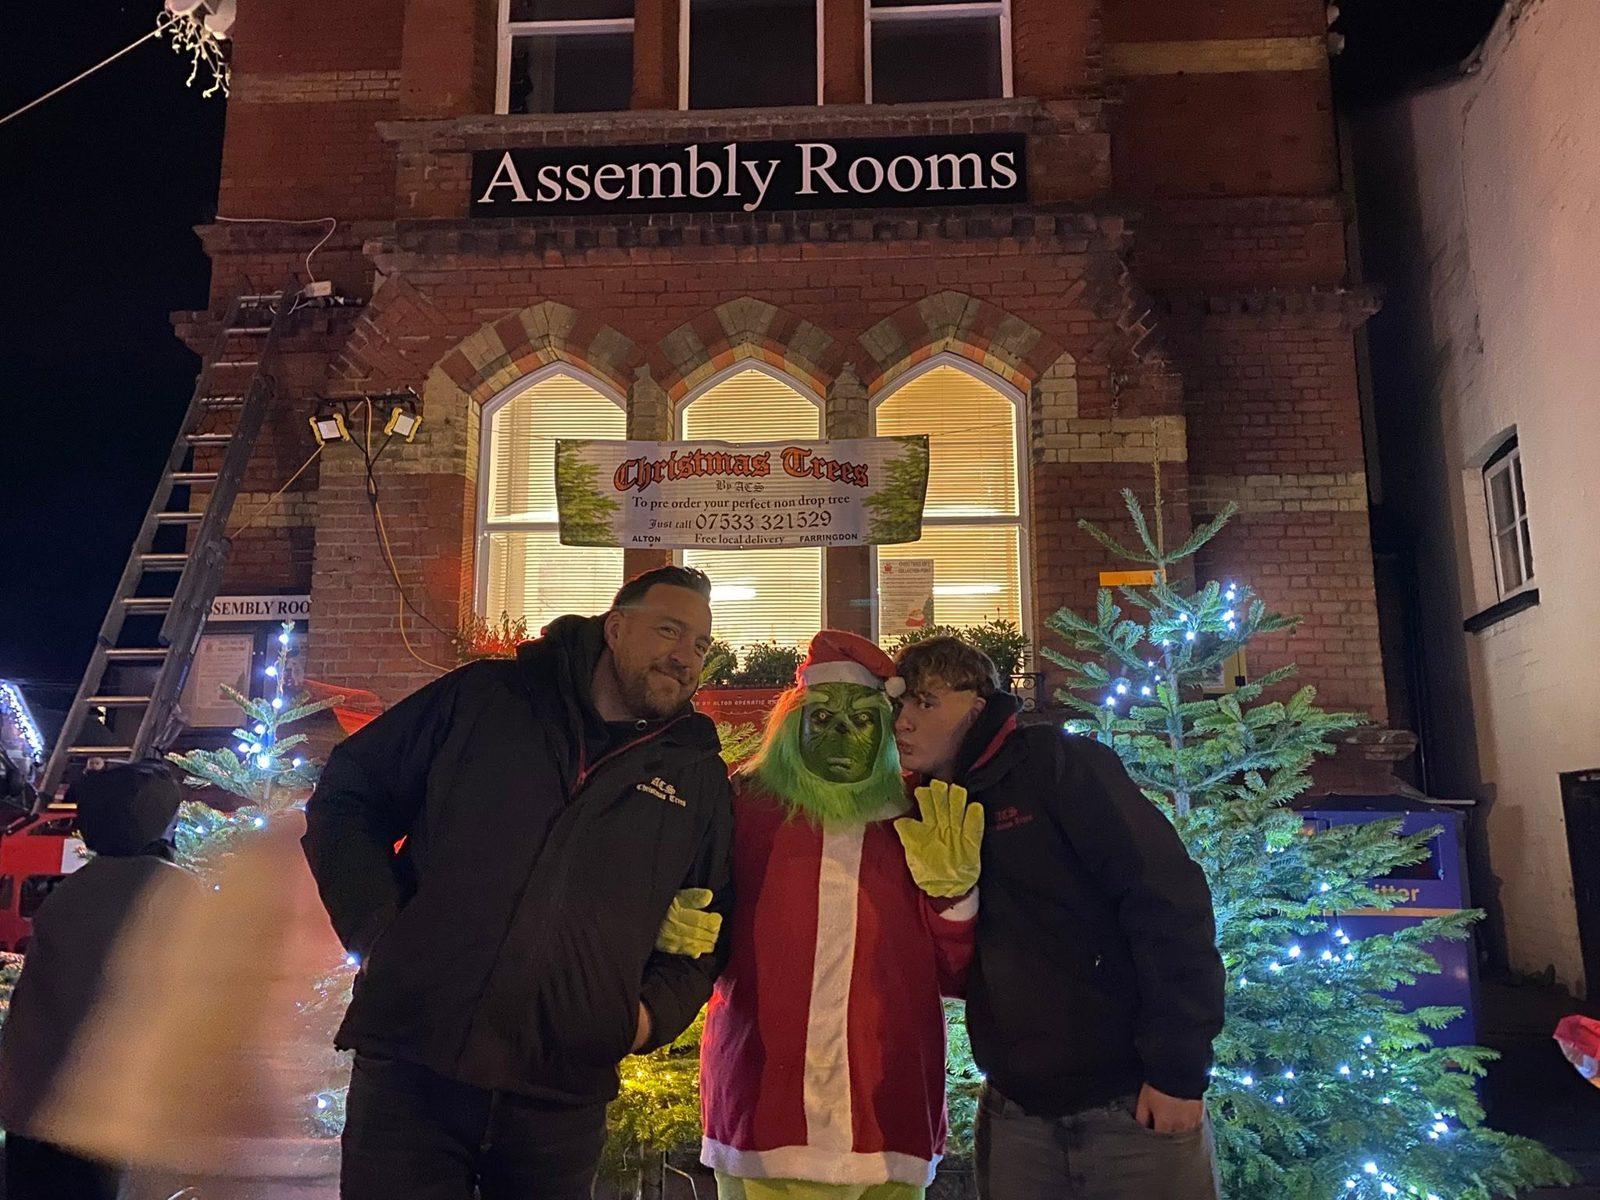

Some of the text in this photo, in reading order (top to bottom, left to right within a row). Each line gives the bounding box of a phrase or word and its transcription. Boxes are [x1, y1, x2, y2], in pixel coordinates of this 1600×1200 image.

[477, 142, 1018, 212] Assembly Rooms
[613, 446, 869, 493] Christmas Trees
[716, 479, 765, 492] By ACS
[632, 495, 850, 511] To pre order your perfect non drop tree
[649, 510, 833, 531] Just call 07533 321529
[632, 535, 661, 543] ALTON
[694, 534, 785, 545] Free local delivery
[800, 533, 858, 543] FARRINGDON
[211, 601, 274, 616] SEMBLY
